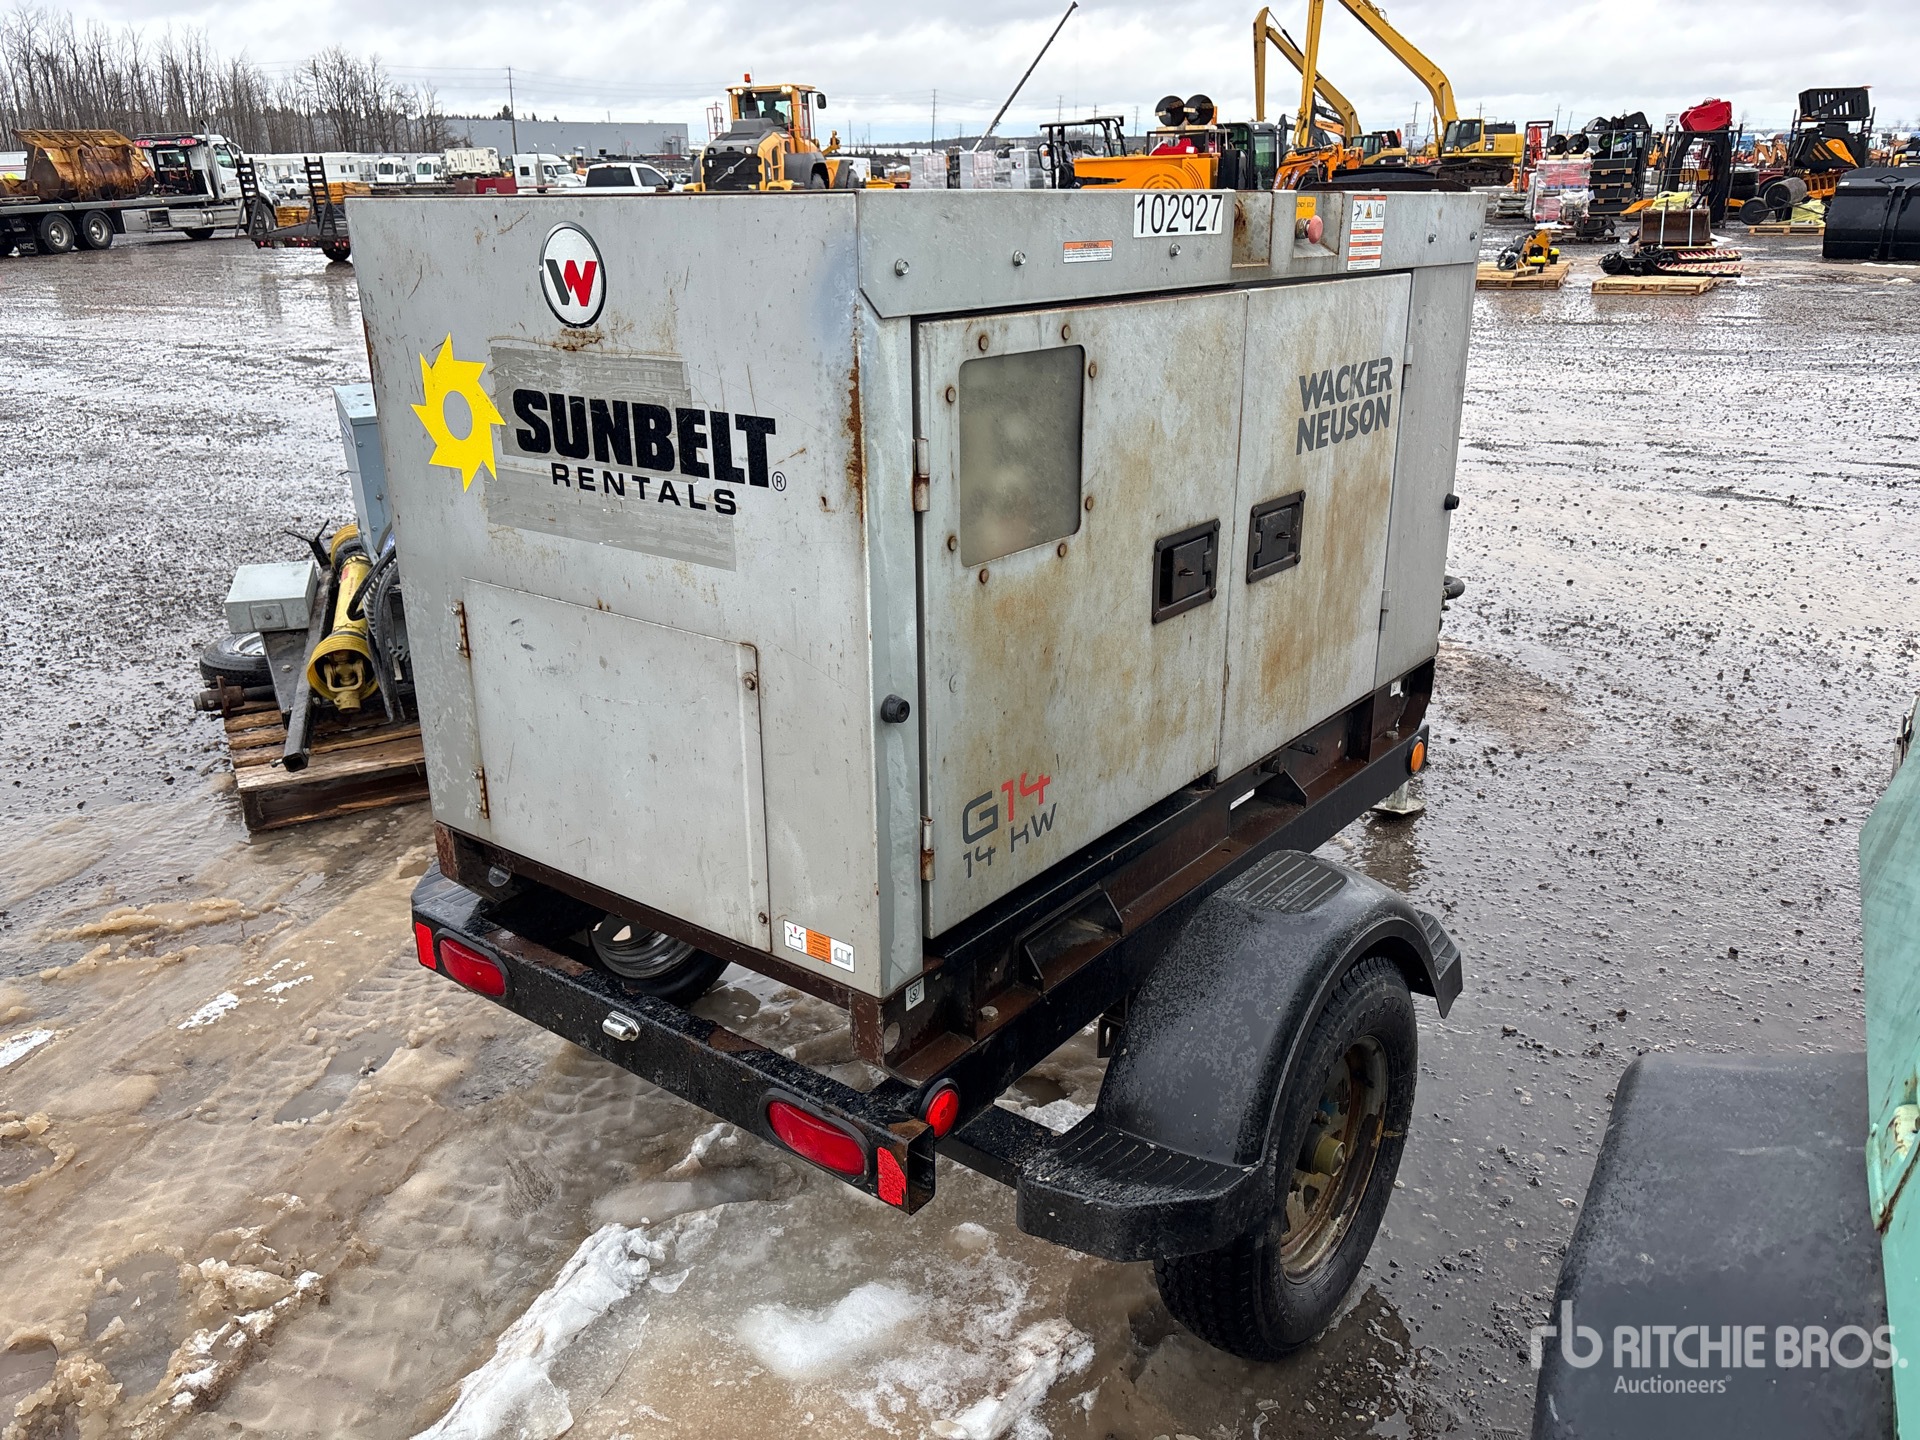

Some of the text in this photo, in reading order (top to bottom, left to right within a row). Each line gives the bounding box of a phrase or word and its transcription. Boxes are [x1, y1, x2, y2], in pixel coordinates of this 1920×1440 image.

[1668, 119, 1675, 128] 2
[1137, 193, 1222, 234] 102927
[1299, 356, 1393, 412] WACKER
[512, 388, 777, 488] SUNBELT
[1296, 394, 1392, 456] NEUSON
[551, 462, 737, 516] RENTALS
[962, 772, 1051, 844] G14
[963, 846, 996, 879] 14
